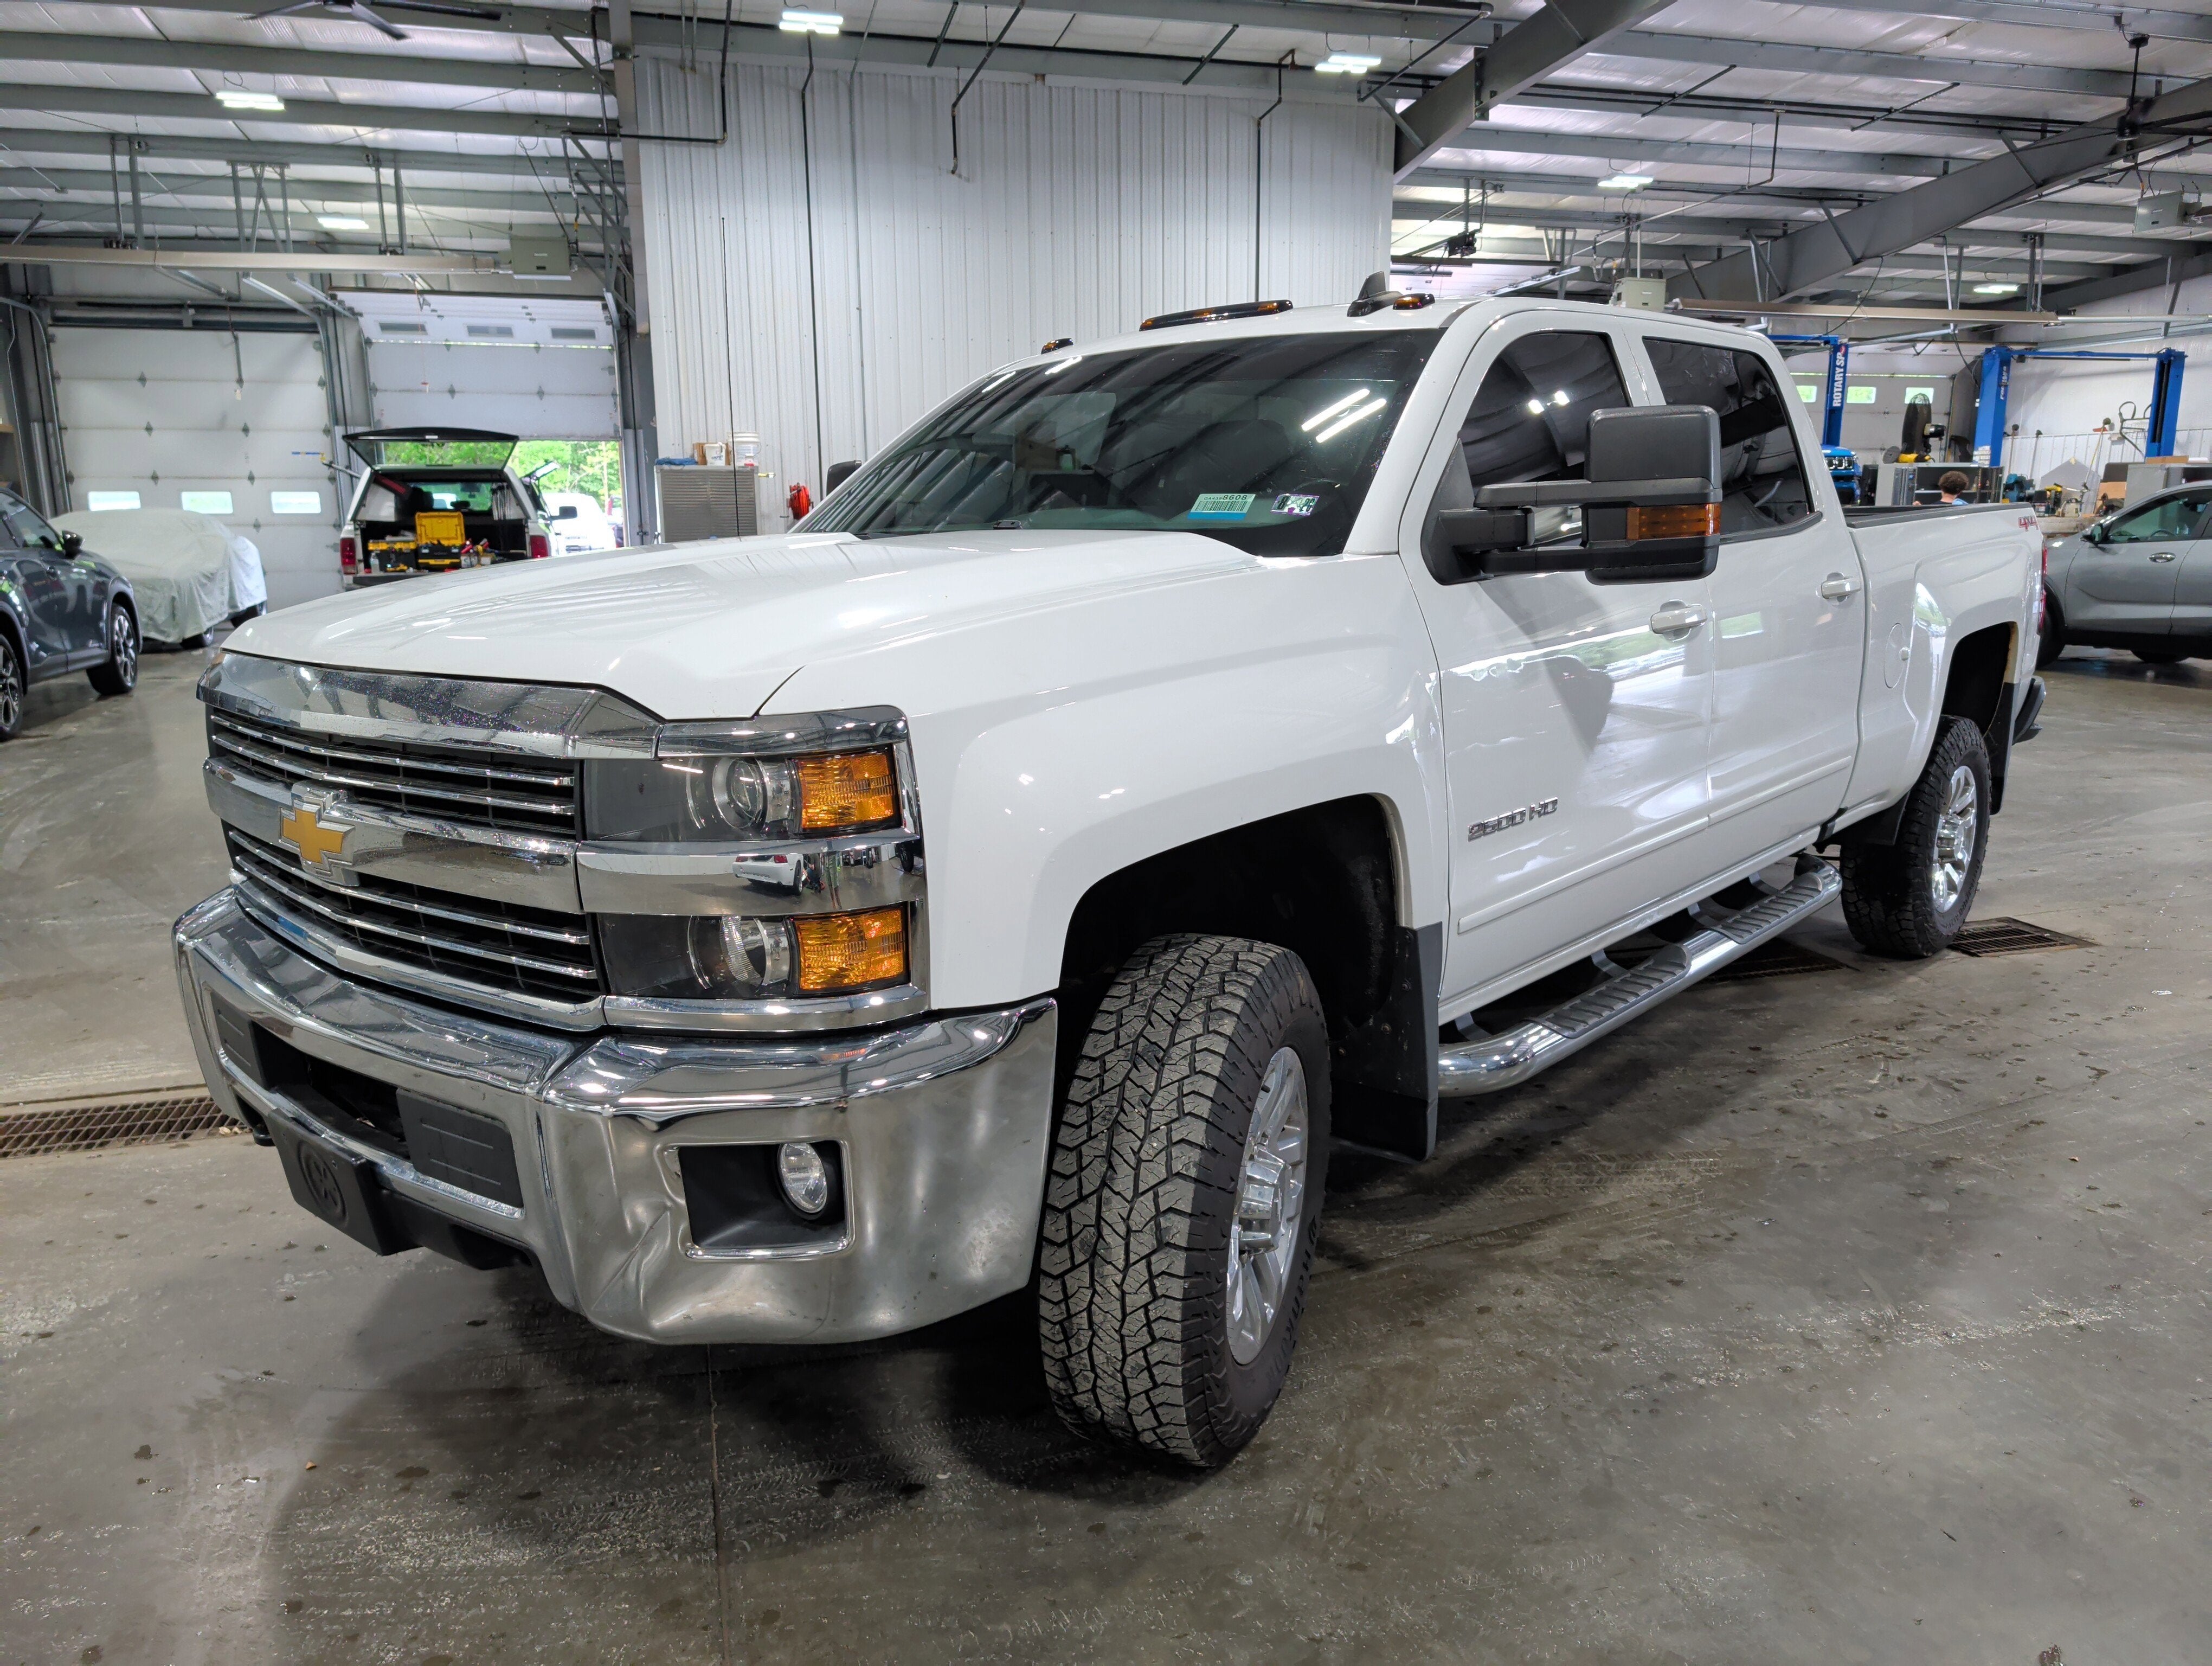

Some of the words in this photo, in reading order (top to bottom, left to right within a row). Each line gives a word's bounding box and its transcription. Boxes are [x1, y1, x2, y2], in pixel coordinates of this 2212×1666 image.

[1832, 367, 1843, 407] ROTARY
[1277, 496, 1290, 510] 8
[1468, 808, 1526, 842] 2500
[1529, 797, 1558, 821] HD
